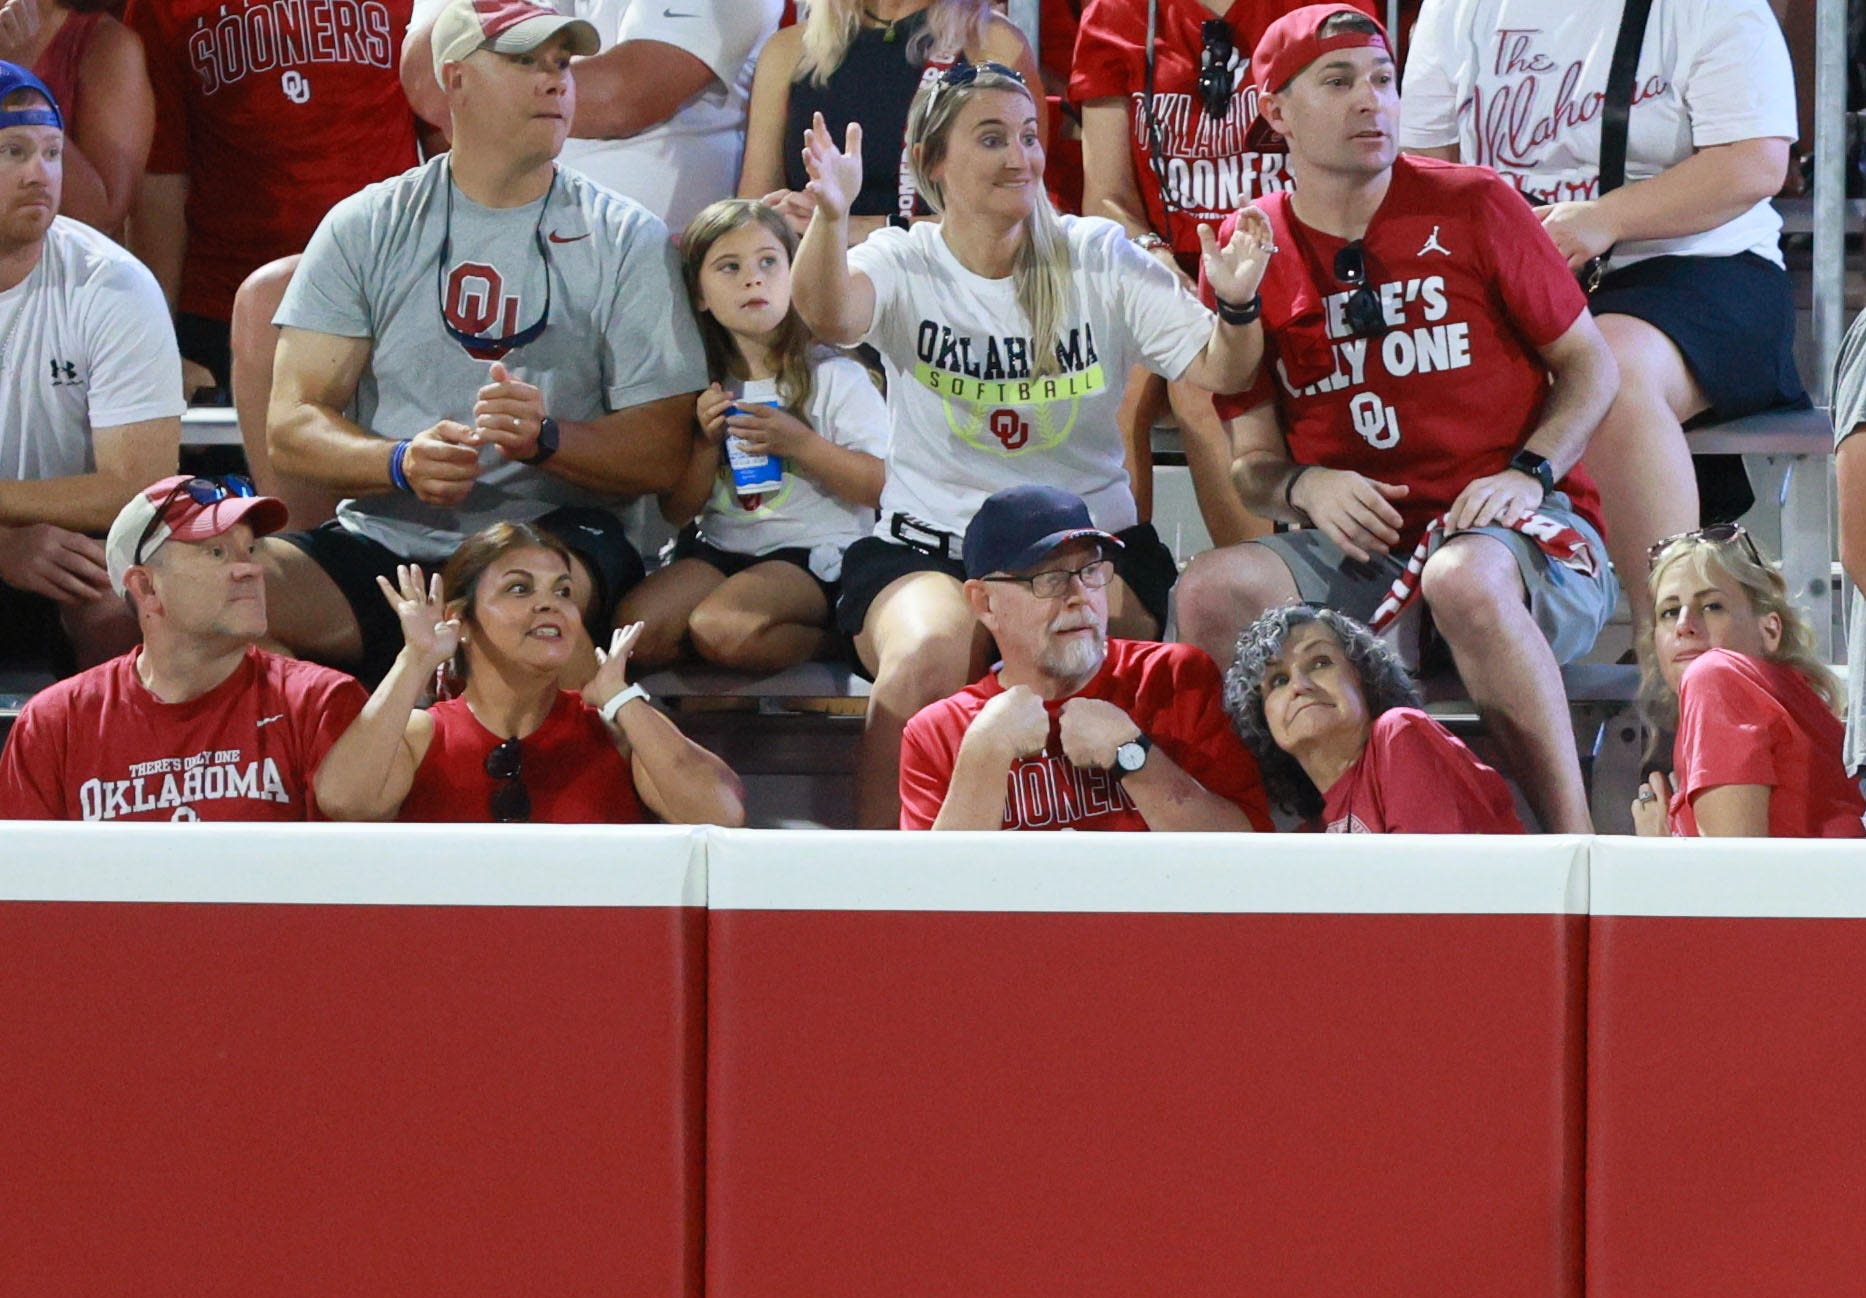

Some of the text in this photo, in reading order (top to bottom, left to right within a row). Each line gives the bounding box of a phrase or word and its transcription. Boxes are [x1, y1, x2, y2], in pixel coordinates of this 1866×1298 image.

[189, 0, 391, 96] SOONERS
[1495, 28, 1555, 76] The
[282, 70, 311, 104] OU
[443, 260, 520, 362] OU
[917, 319, 1098, 380] OKLAHMA
[1382, 322, 1471, 377] ONE
[930, 371, 1092, 402] SOFTBALL
[990, 409, 1029, 450] OU
[1350, 391, 1400, 449] OU
[80, 757, 290, 821] OKLAHOMA
[129, 758, 181, 778] THERE'S
[214, 749, 240, 764] ONE
